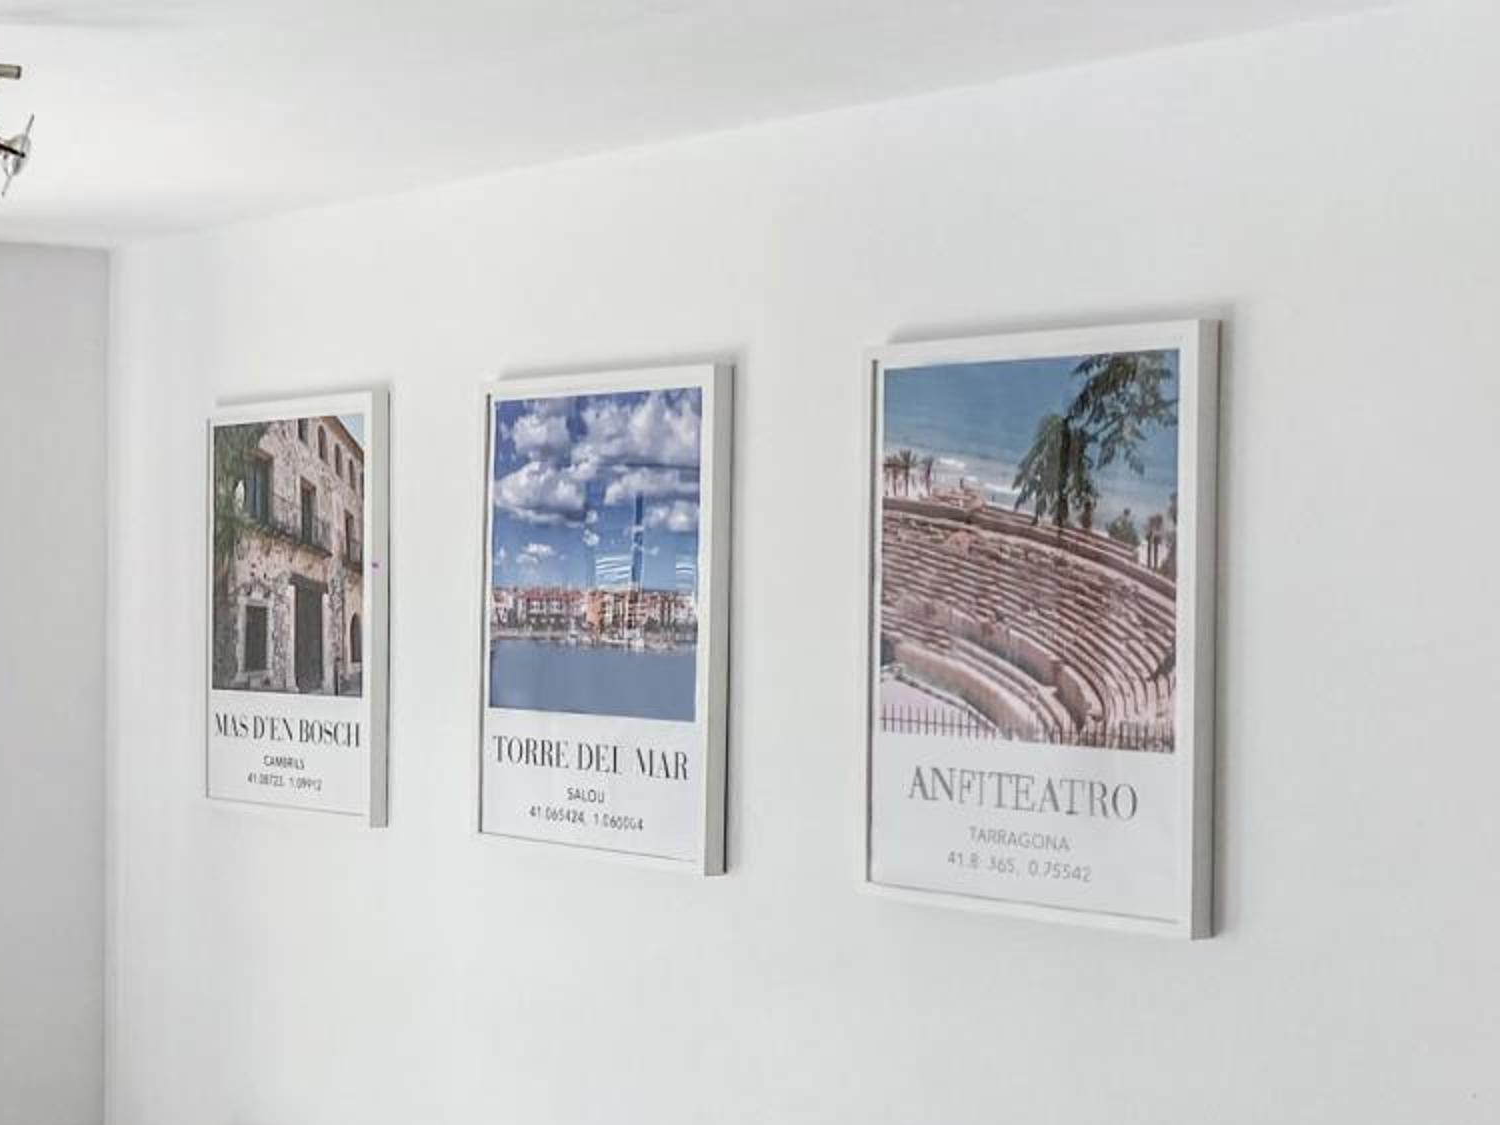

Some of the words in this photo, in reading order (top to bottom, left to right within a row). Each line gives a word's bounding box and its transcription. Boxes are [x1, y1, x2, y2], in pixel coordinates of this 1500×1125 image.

[214, 712, 249, 738] MAS
[253, 715, 294, 742] D'EN
[299, 718, 361, 748] BOSCH
[492, 735, 570, 770] TORRE
[578, 743, 623, 775] DEL
[636, 746, 689, 780] MAR
[566, 787, 605, 803] SALOU
[908, 765, 1139, 821] ANFITEATRO
[968, 826, 1072, 852] TARRAGONA
